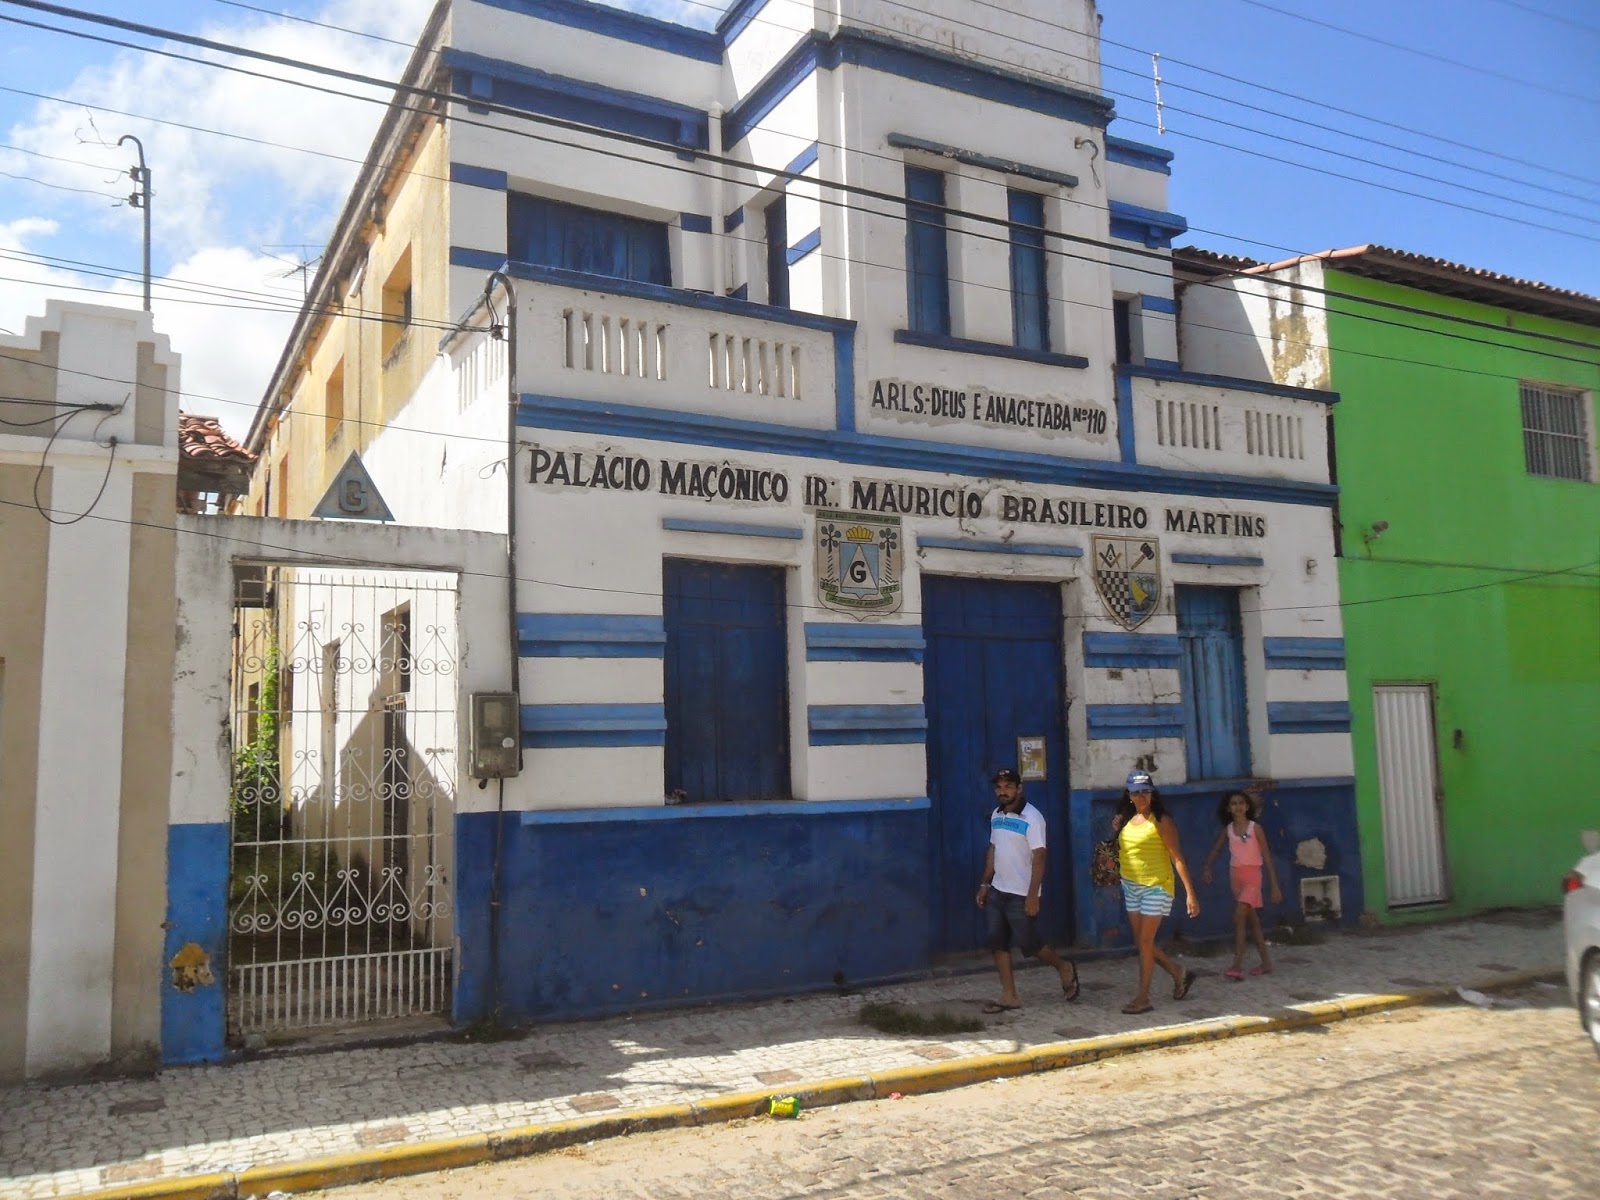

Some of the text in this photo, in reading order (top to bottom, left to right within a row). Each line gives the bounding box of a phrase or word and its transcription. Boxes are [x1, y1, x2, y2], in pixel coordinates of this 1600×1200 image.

[973, 393, 981, 420] E
[985, 395, 1072, 432] ANACETABA
[339, 477, 368, 513] G
[528, 446, 650, 491] PALÁCIO
[659, 460, 788, 502] MAÇÔNICO
[851, 480, 982, 519] MAURICIO
[1002, 495, 1148, 529] BRASILEIRO
[1165, 508, 1265, 538] MARTINS
[849, 560, 867, 584] G
